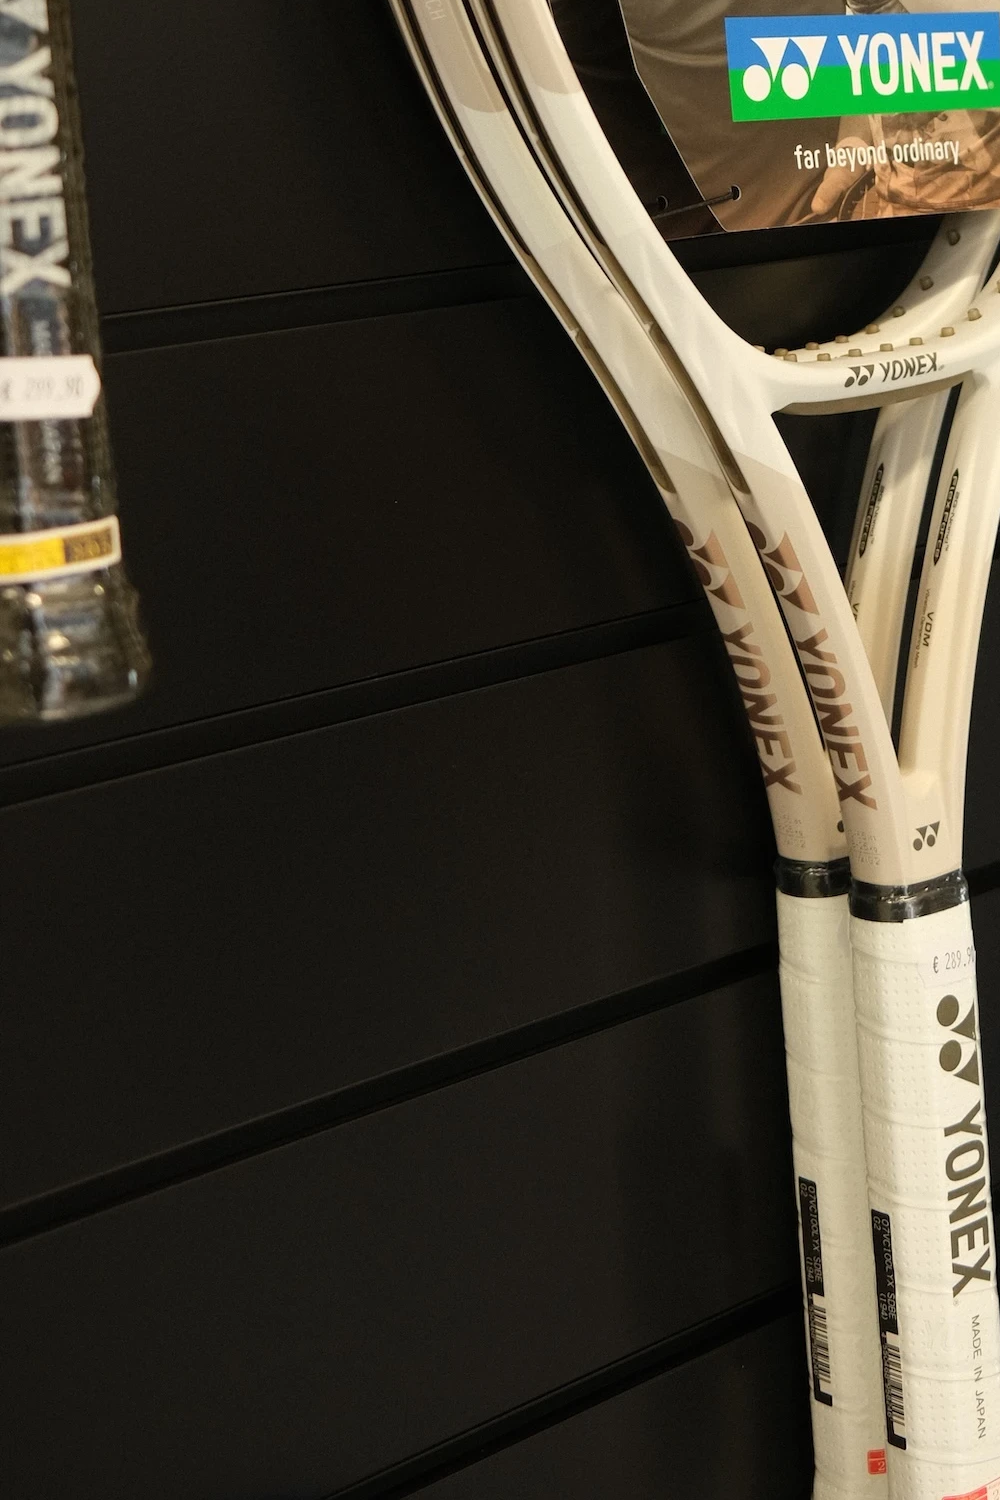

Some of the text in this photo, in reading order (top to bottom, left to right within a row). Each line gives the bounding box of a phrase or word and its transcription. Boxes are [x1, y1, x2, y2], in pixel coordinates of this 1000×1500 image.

[836, 30, 989, 96] YONEX
[0, 46, 72, 292] YONEX
[793, 137, 960, 173] far beyond ordinary
[878, 351, 940, 384] YONEX
[923, 611, 935, 647] VDM
[721, 621, 803, 796] YONEX
[794, 629, 878, 811] YONEX
[944, 1099, 992, 1298] YONEX
[873, 1215, 889, 1321] G2 (194)
[970, 1313, 986, 1440] MADE IN JAPAN
